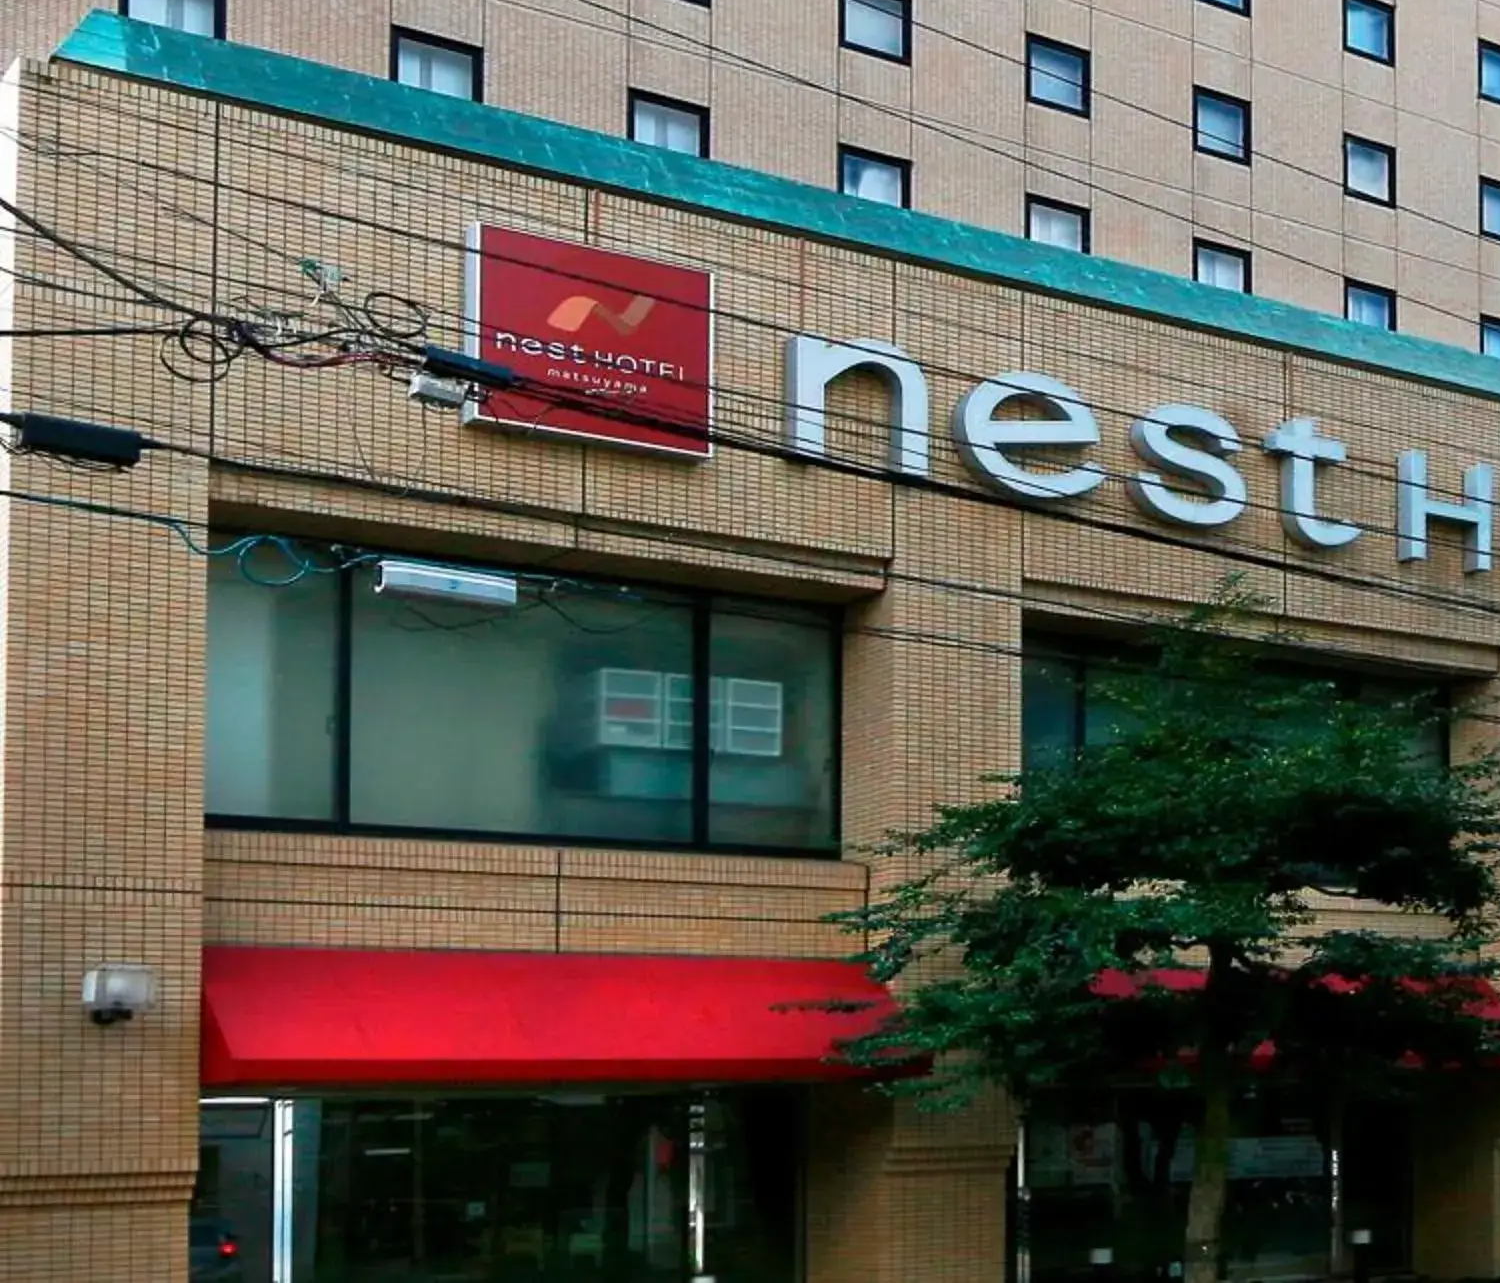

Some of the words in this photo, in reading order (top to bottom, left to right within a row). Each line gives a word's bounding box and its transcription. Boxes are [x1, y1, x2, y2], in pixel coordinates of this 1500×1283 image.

[496, 331, 586, 365] nest
[546, 367, 648, 394] matsuyama
[786, 334, 1363, 549] nest
